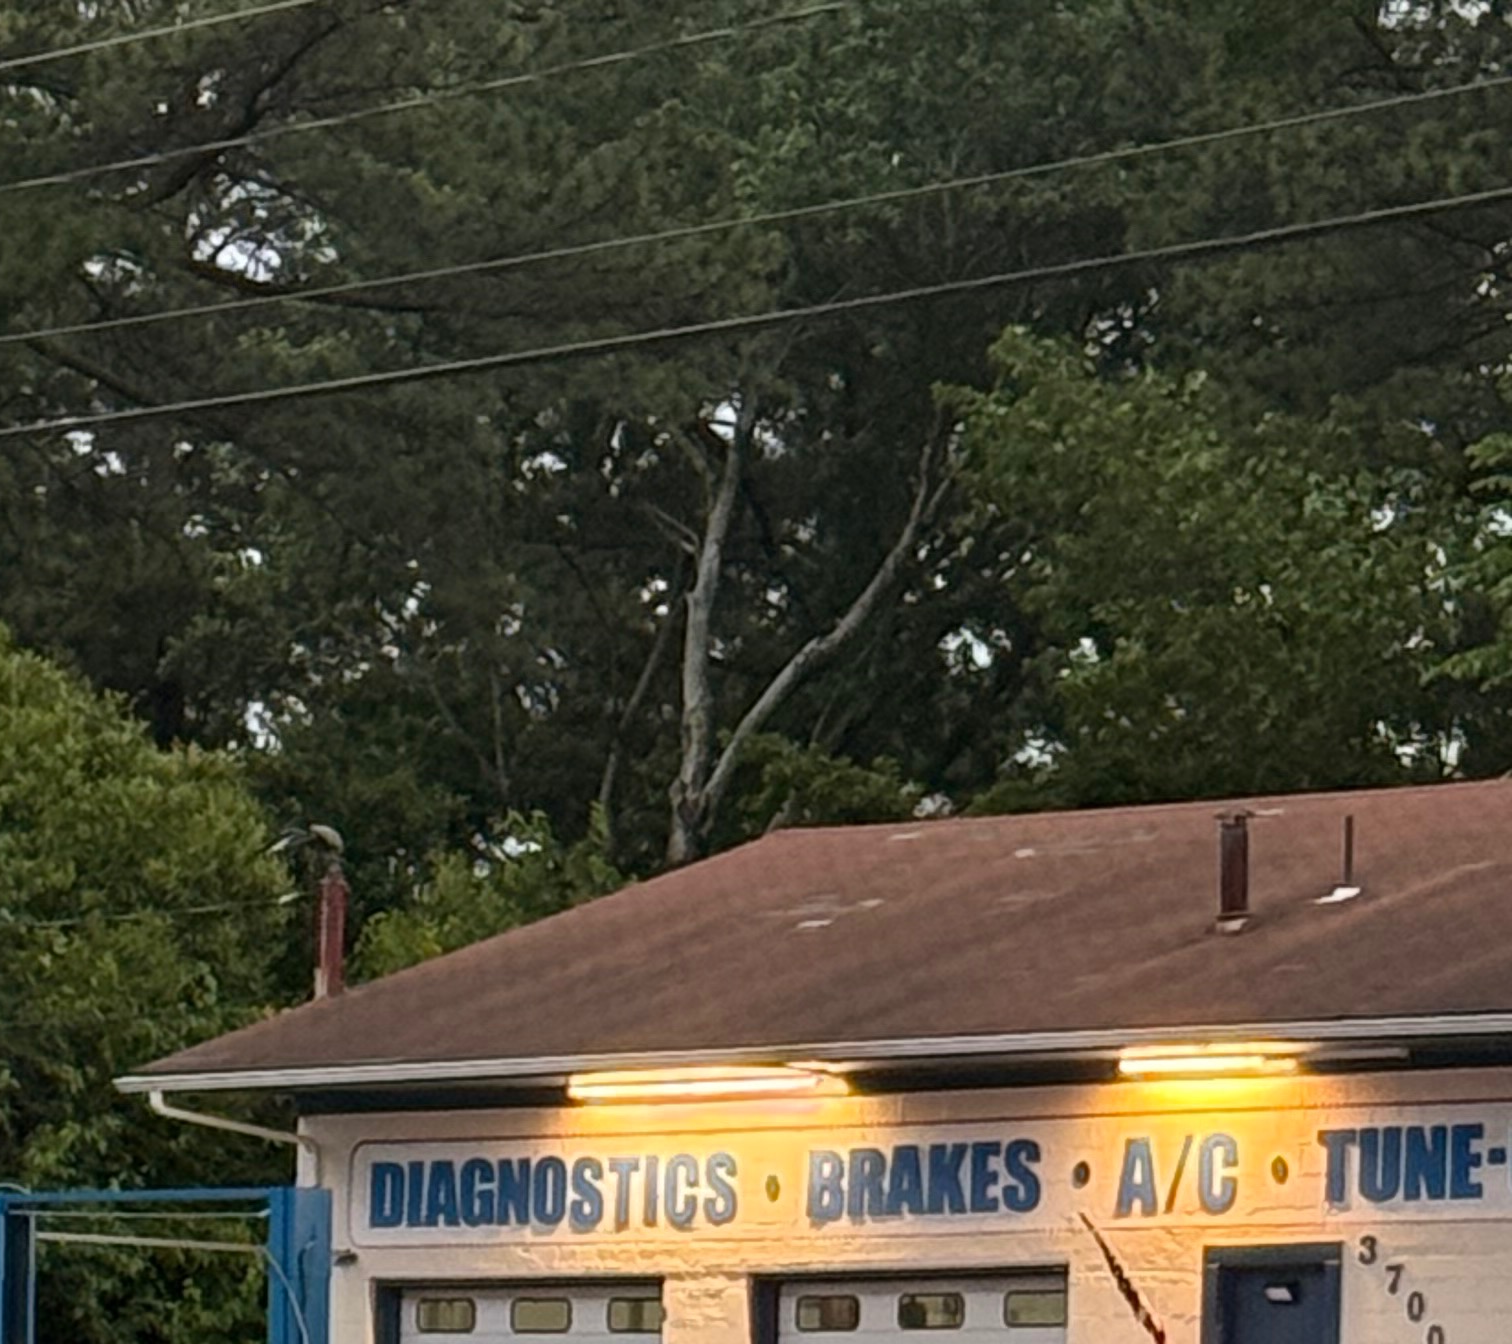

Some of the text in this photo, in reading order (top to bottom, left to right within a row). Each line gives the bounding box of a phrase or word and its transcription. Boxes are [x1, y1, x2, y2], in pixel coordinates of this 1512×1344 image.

[369, 1153, 738, 1232] DIAGNOSTICS
[806, 1138, 1041, 1226] BRAKES
[1114, 1133, 1238, 1218] A/C
